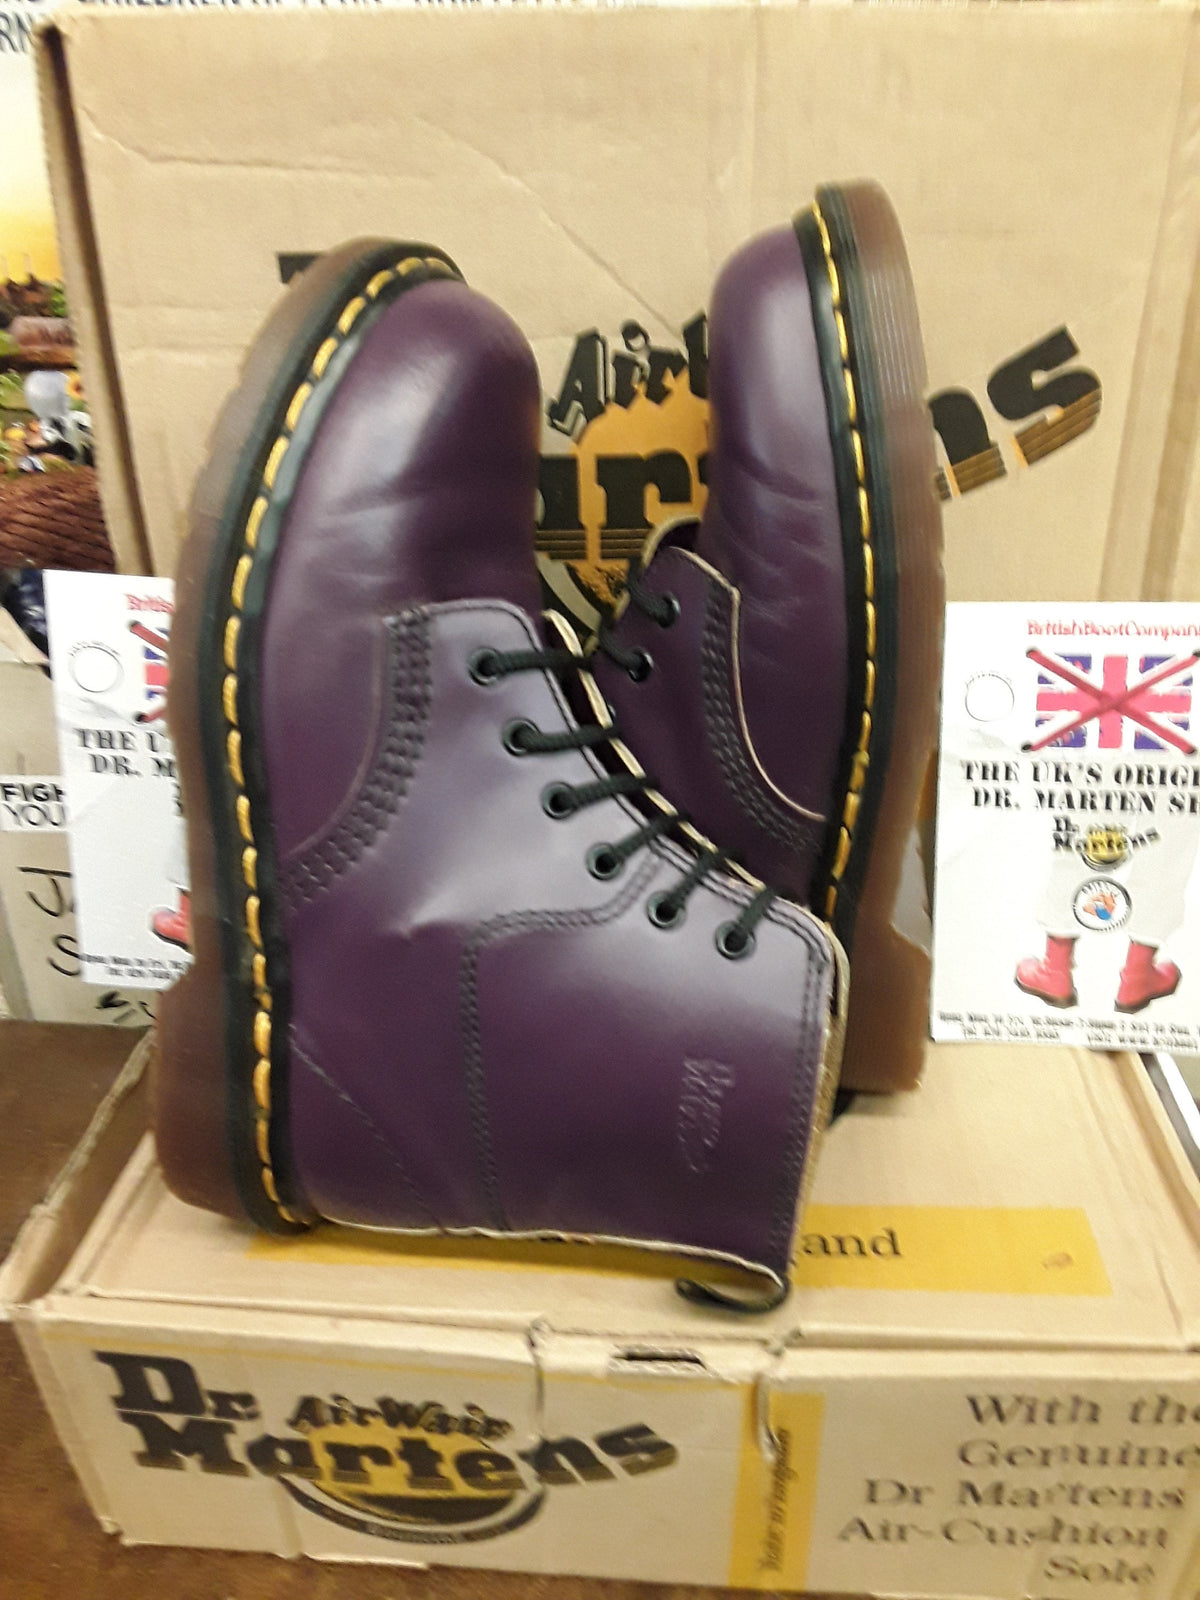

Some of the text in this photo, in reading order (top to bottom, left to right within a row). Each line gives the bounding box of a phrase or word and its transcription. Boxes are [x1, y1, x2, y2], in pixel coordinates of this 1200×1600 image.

[74, 728, 137, 751] THE
[960, 760, 1020, 782] THE
[1031, 761, 1103, 784] UK'S
[972, 787, 1021, 811] DR.
[1035, 788, 1156, 813] MARTEN
[965, 1393, 1101, 1426] With
[116, 1412, 679, 1489] Martens
[957, 1437, 1200, 1469] Genuine
[865, 1477, 1186, 1509] Dr Martens
[1043, 1556, 1156, 1584] Sole
